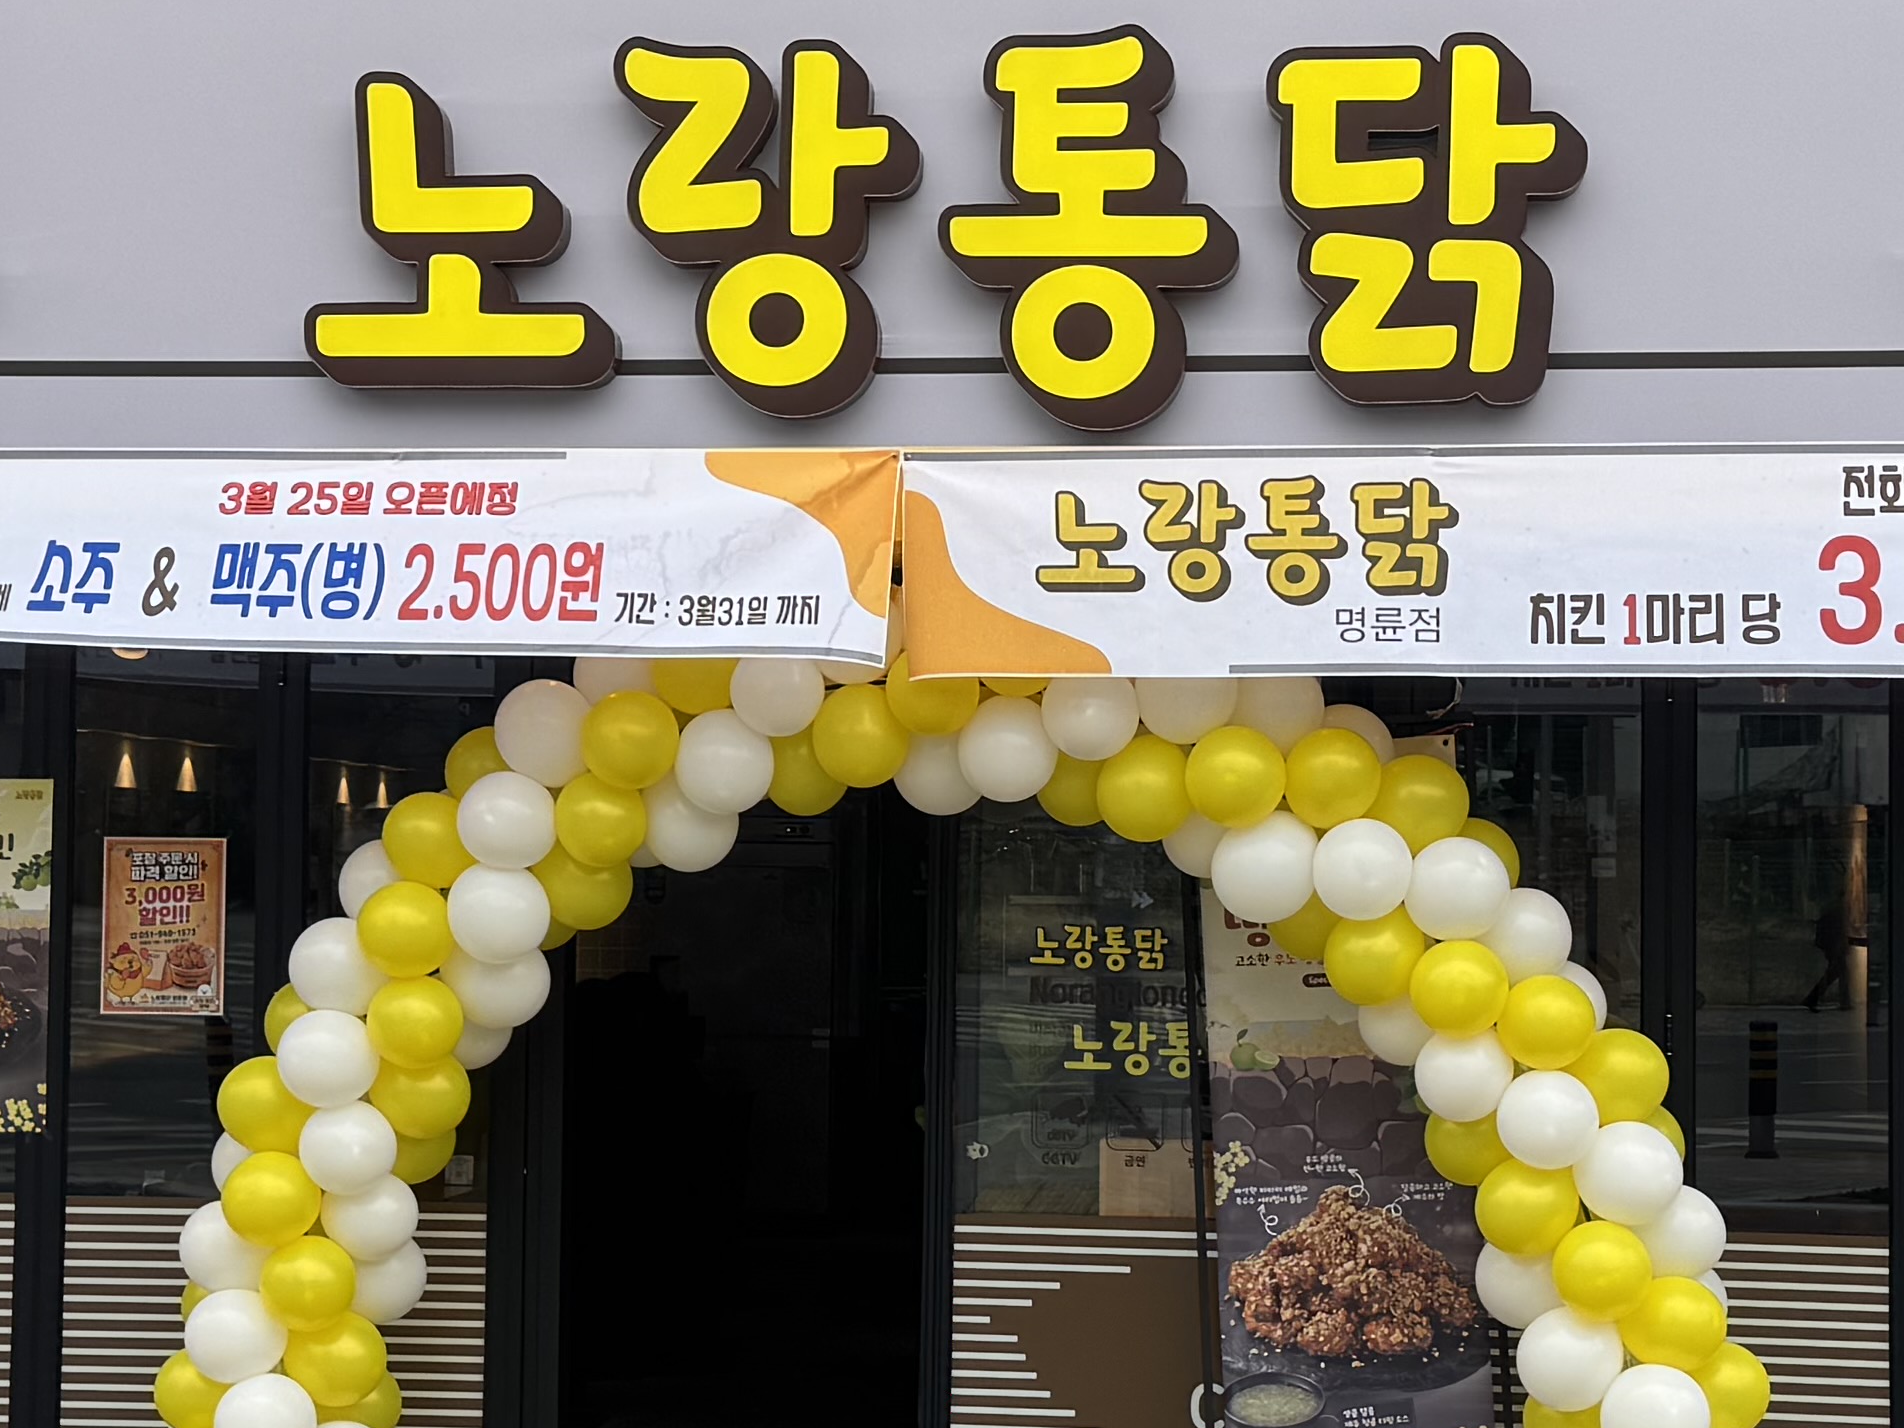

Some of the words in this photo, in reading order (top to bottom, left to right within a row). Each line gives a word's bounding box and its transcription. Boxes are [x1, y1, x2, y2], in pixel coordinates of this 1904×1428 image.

[308, 28, 1568, 417] 노랑통닭
[218, 480, 277, 516] 3월
[286, 480, 373, 516] 25일
[381, 480, 520, 517] 오픈예정
[1034, 475, 1460, 607] 노랑통닭
[26, 539, 120, 614] 소주
[142, 546, 178, 616] &
[210, 541, 386, 621] 맥주(병)
[397, 541, 605, 623] 2.500원
[614, 592, 657, 625] 기간
[677, 593, 767, 627] 3월31일
[774, 592, 822, 627] 까지
[1334, 606, 1443, 644] 명륜점
[1529, 592, 1607, 646] 치킨
[1622, 592, 1726, 646] 1마리
[1742, 592, 1781, 645] 당
[1029, 925, 1169, 971] 노랑통닭
